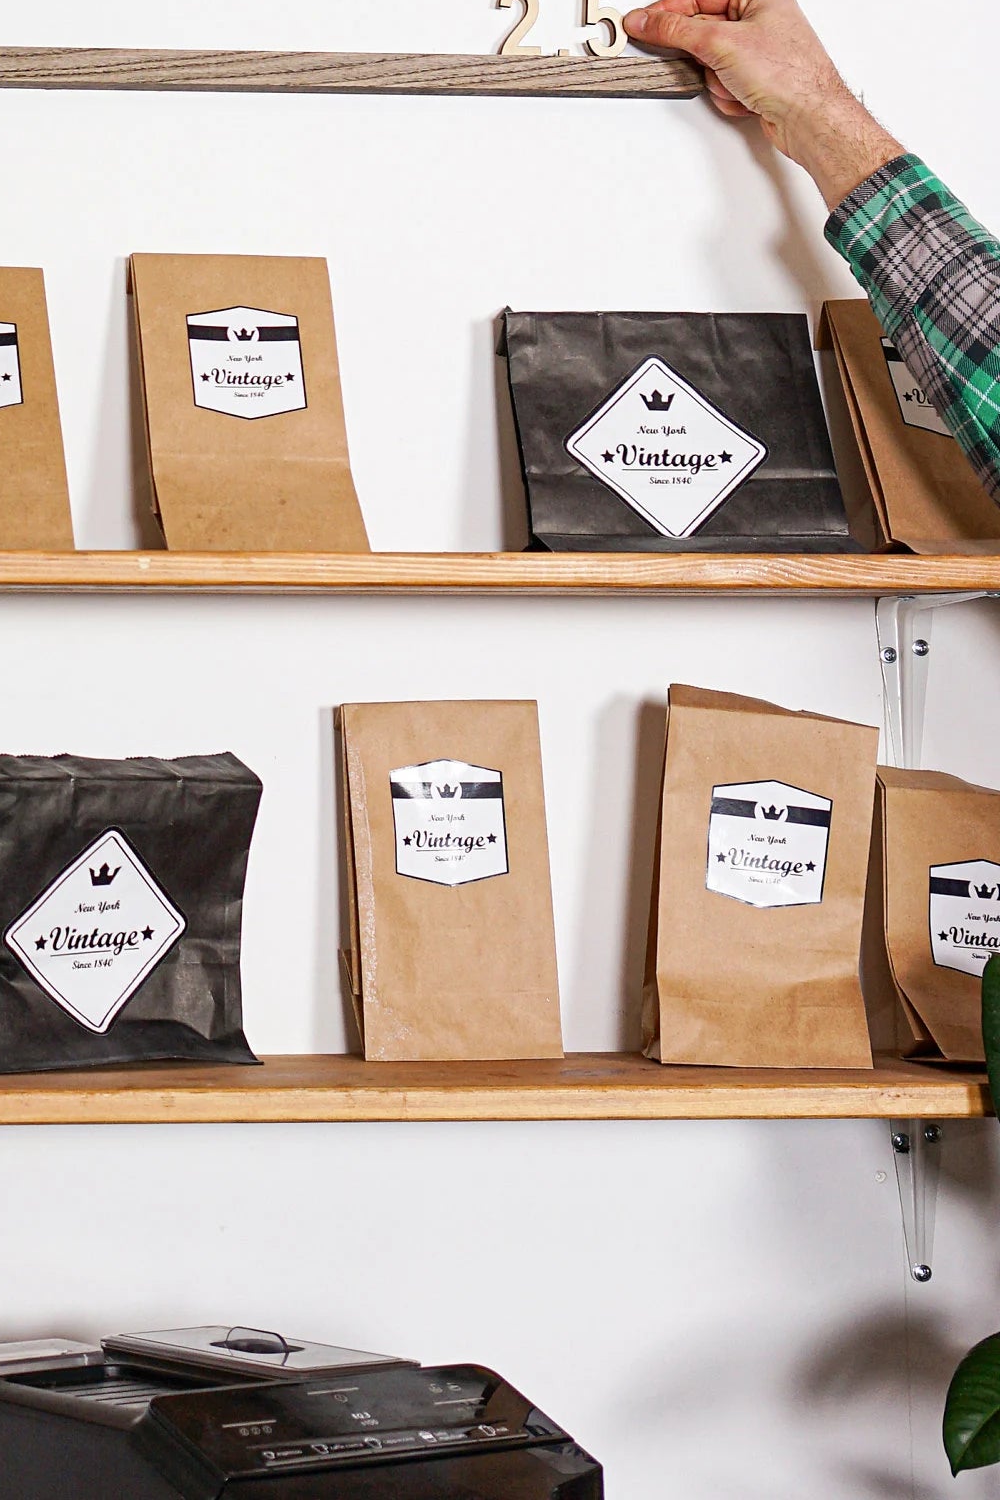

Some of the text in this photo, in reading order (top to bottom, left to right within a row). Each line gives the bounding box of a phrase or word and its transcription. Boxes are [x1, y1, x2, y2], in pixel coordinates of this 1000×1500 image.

[244, 355, 263, 363] York
[211, 368, 284, 390] Vintage
[637, 425, 687, 437] New York
[615, 443, 718, 475] Vintage
[649, 477, 692, 485] Since 1840
[413, 830, 486, 853] Vintage
[747, 834, 787, 845] New York
[728, 847, 803, 877] Vintage
[74, 900, 120, 914] New York
[964, 912, 981, 921] New
[50, 926, 139, 956] Vintage
[949, 926, 1000, 948] Vinta
[72, 959, 114, 969] Since 1840
